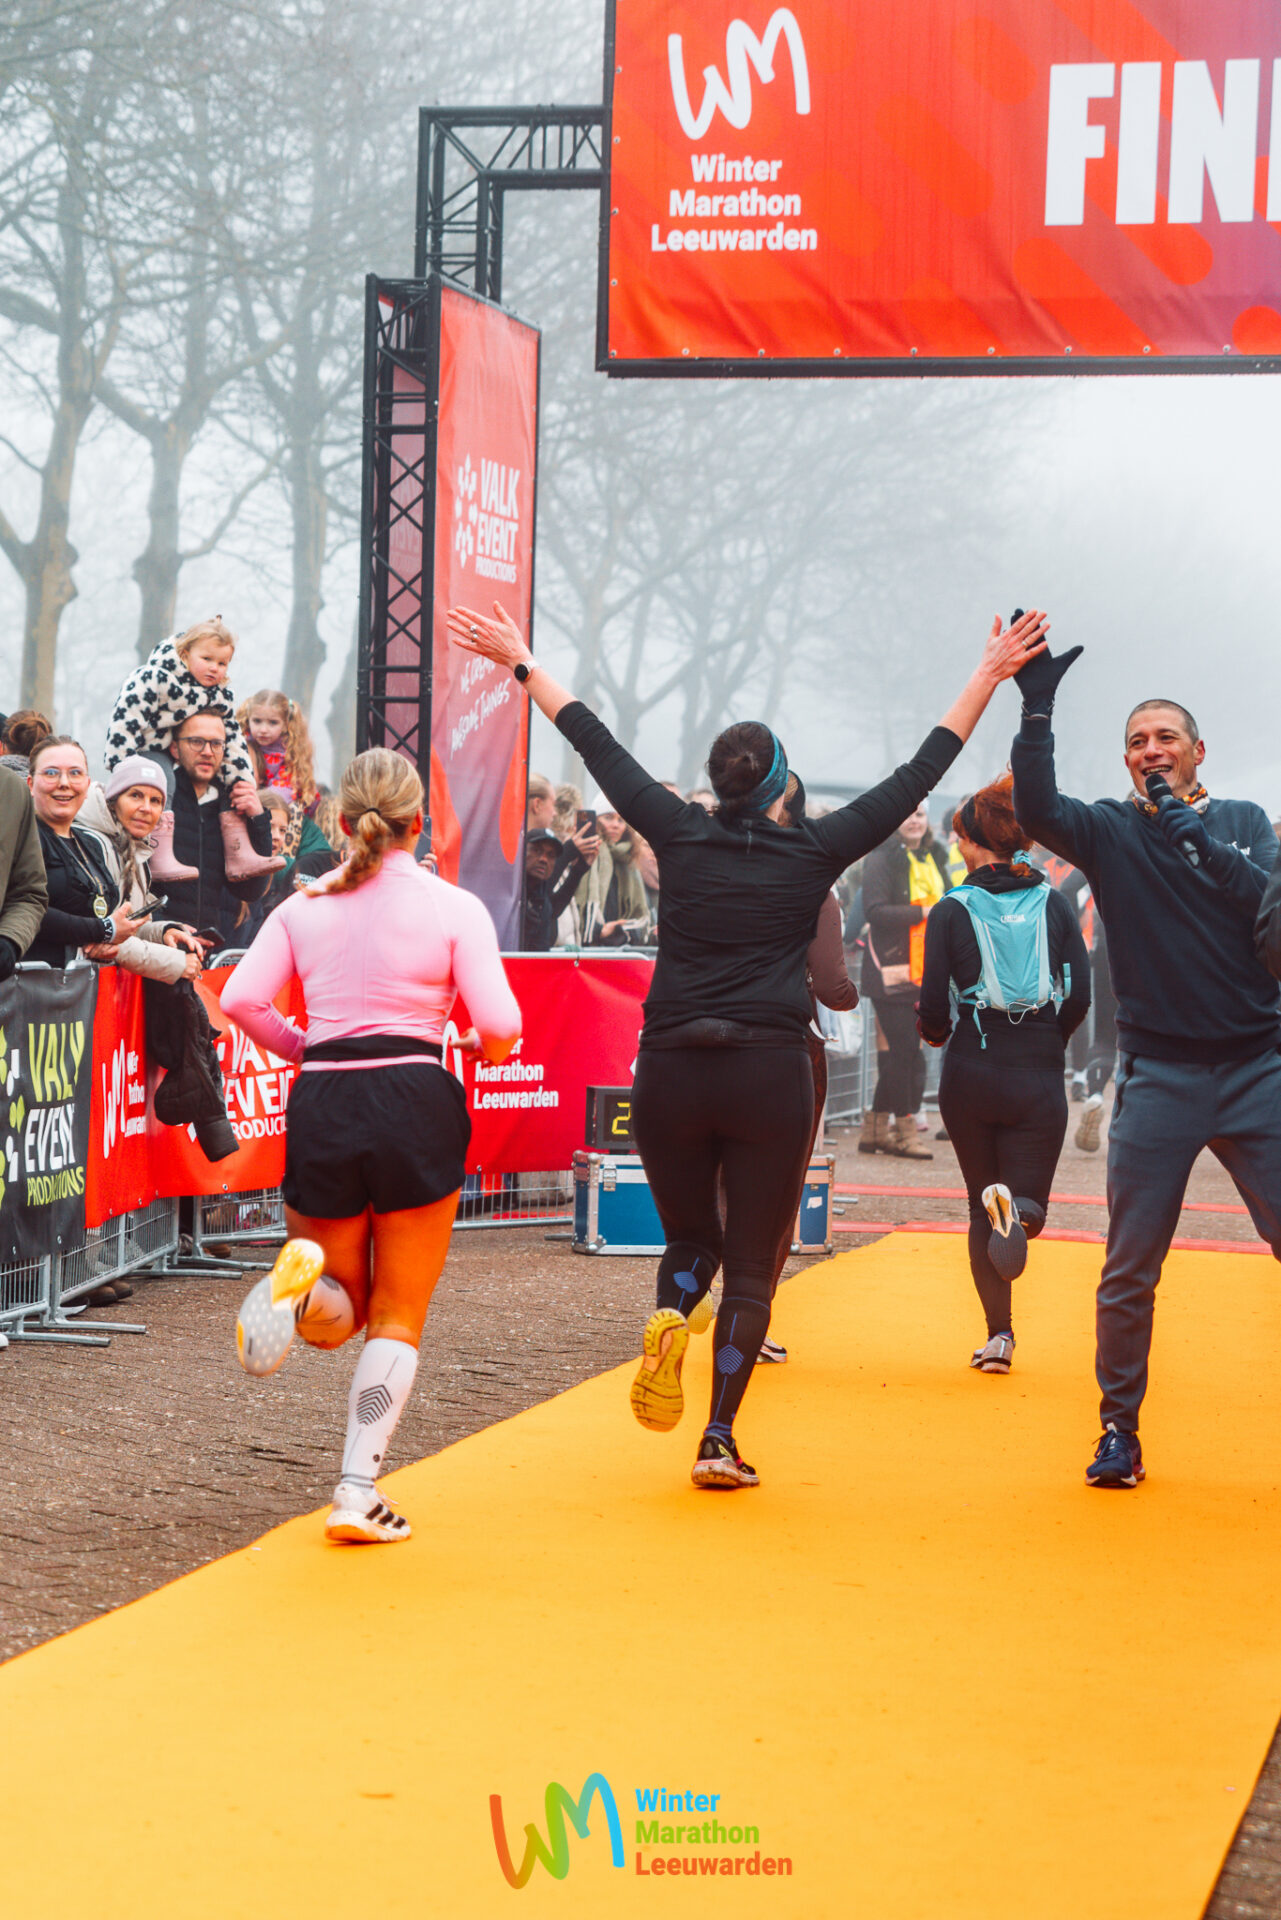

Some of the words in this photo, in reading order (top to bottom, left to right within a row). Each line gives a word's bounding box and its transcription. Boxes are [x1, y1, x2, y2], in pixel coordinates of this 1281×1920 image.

[1044, 57, 1281, 226] FIN
[690, 152, 783, 182] Winter
[669, 187, 802, 217] Marathon
[651, 221, 818, 252] Leeuwarden
[481, 457, 520, 520] VALK
[477, 511, 519, 562] EVENT
[475, 1059, 544, 1082] Marathon
[473, 1085, 559, 1110] Leeuwarden
